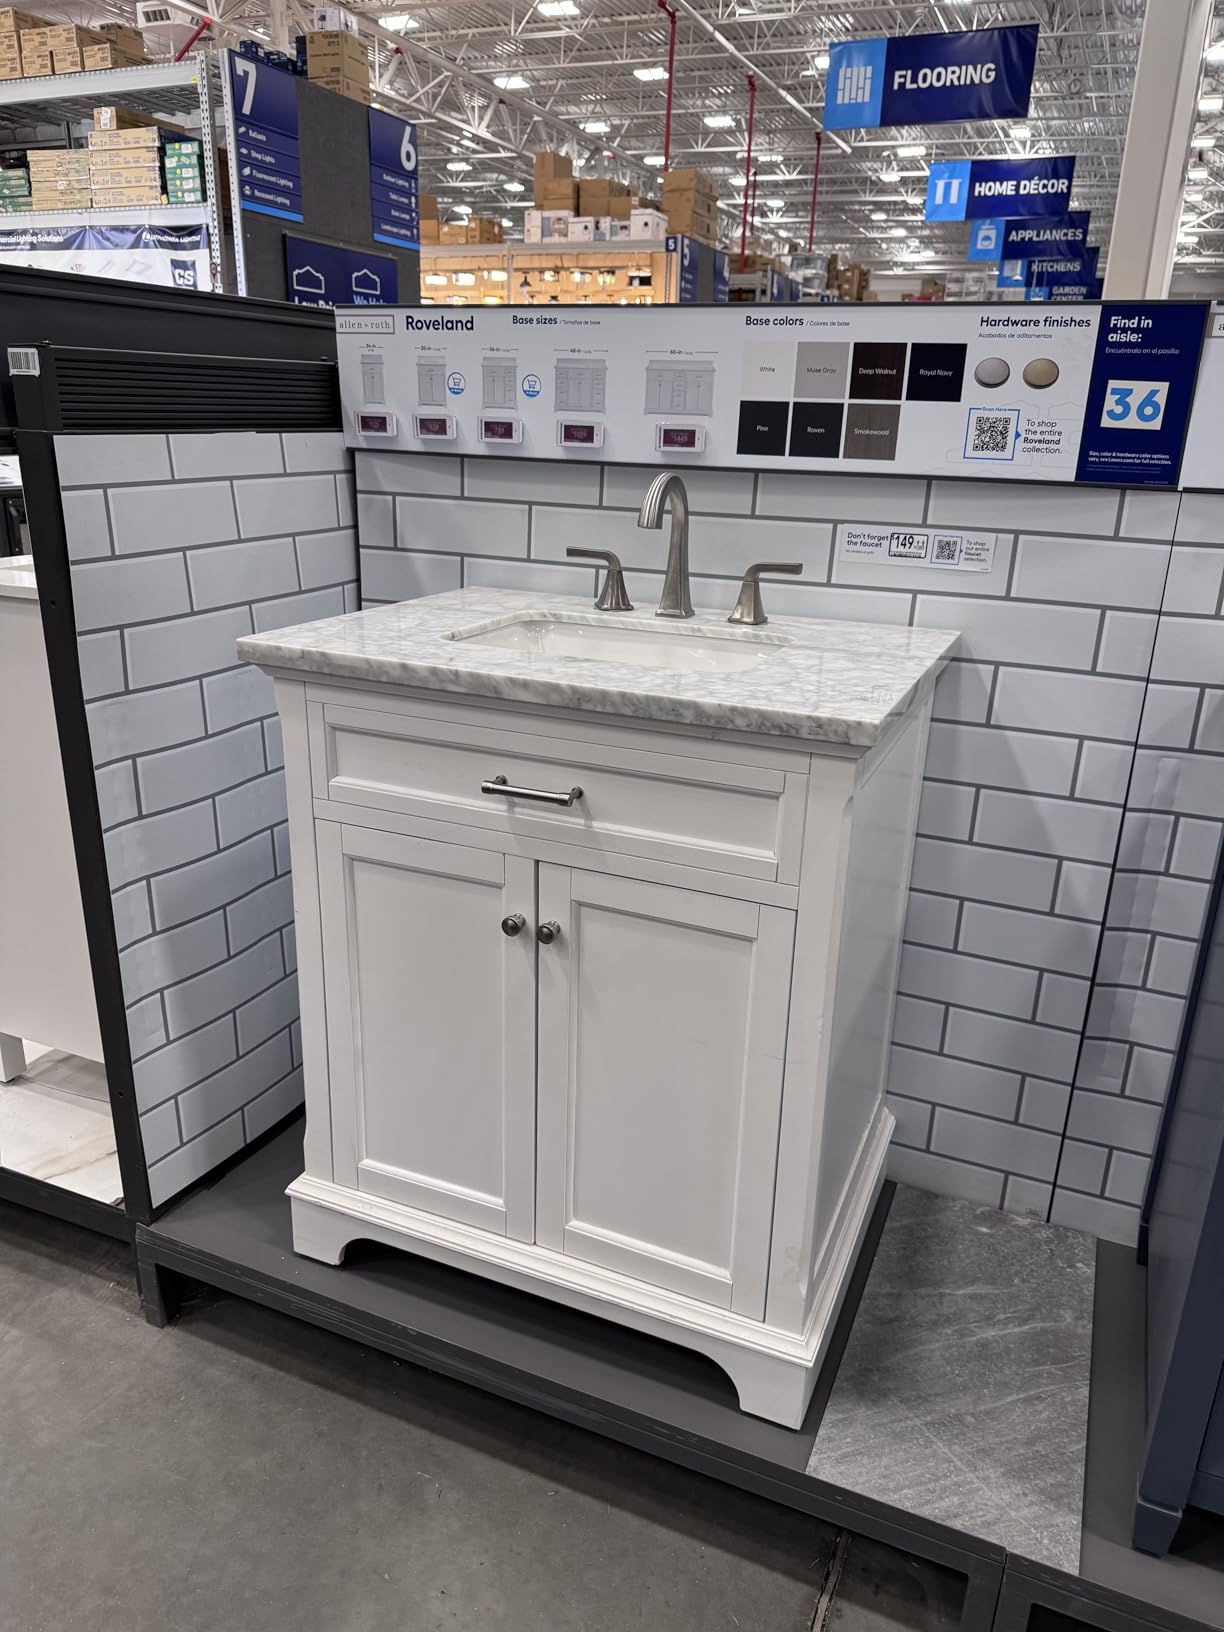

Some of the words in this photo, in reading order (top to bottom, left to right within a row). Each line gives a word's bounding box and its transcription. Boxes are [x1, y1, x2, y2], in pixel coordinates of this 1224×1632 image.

[892, 62, 996, 91] FLOORING
[234, 56, 257, 116] 7
[400, 125, 417, 172] 6
[277, 176, 293, 189] Lighting
[974, 180, 1017, 197] HOME
[1019, 176, 1069, 195] DÉCOR
[17, 234, 37, 244] Lighting
[37, 234, 64, 243] Solutions
[1008, 228, 1084, 242] APPLIANCES
[668, 239, 675, 250] 5
[683, 238, 690, 266] 5
[1031, 262, 1081, 272] KITCHENS
[173, 268, 195, 287] CS
[1051, 286, 1088, 295] GARDEN
[405, 315, 474, 331] Roveland
[512, 315, 534, 325] Base
[535, 315, 558, 325] sizes
[745, 315, 770, 326] Base
[773, 315, 804, 326] colors
[980, 316, 1040, 327] Hardware
[1043, 316, 1091, 328] finishes
[1110, 316, 1138, 328] Find
[1140, 316, 1153, 328] in
[1108, 330, 1142, 342] aisle:
[822, 367, 837, 376] Gray
[858, 367, 874, 376] Deep
[875, 367, 897, 375] Walnut
[919, 368, 937, 377] Royal
[937, 369, 953, 377] Navy
[1106, 387, 1161, 423] 36
[1026, 419, 1035, 427] To
[1037, 420, 1057, 428] shop
[807, 426, 825, 434] Raven
[854, 428, 890, 436] Smokewood
[1025, 428, 1039, 436] the
[1039, 429, 1063, 437] entire
[1023, 437, 1061, 445] Roveland
[1022, 446, 1062, 454] collection.
[847, 532, 865, 540] Don't
[867, 534, 889, 542] forget
[859, 540, 882, 548] faucet
